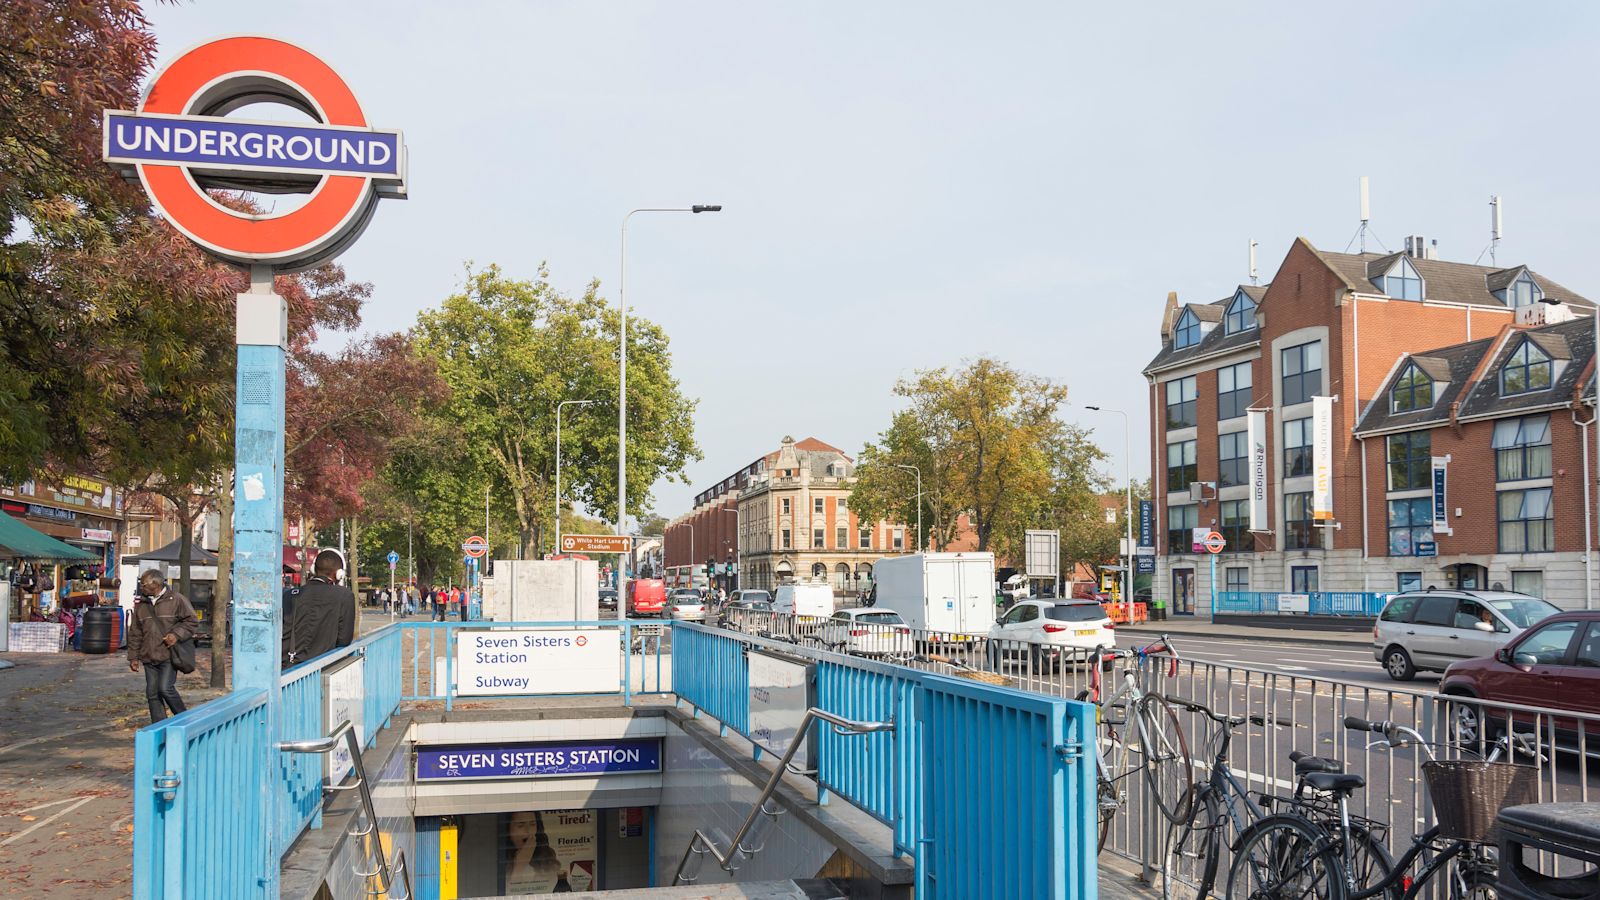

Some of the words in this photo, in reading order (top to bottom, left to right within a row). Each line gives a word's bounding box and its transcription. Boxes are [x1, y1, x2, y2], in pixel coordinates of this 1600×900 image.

[116, 124, 391, 166] UNDERGROUND
[476, 636, 518, 648] Seven
[523, 635, 571, 647] Sisters
[476, 652, 527, 663] Station
[476, 676, 529, 689] Subway
[439, 754, 494, 770] SEVEN
[501, 751, 564, 767] SISTERS
[570, 749, 639, 765] STATION
[558, 814, 590, 824] Tired?
